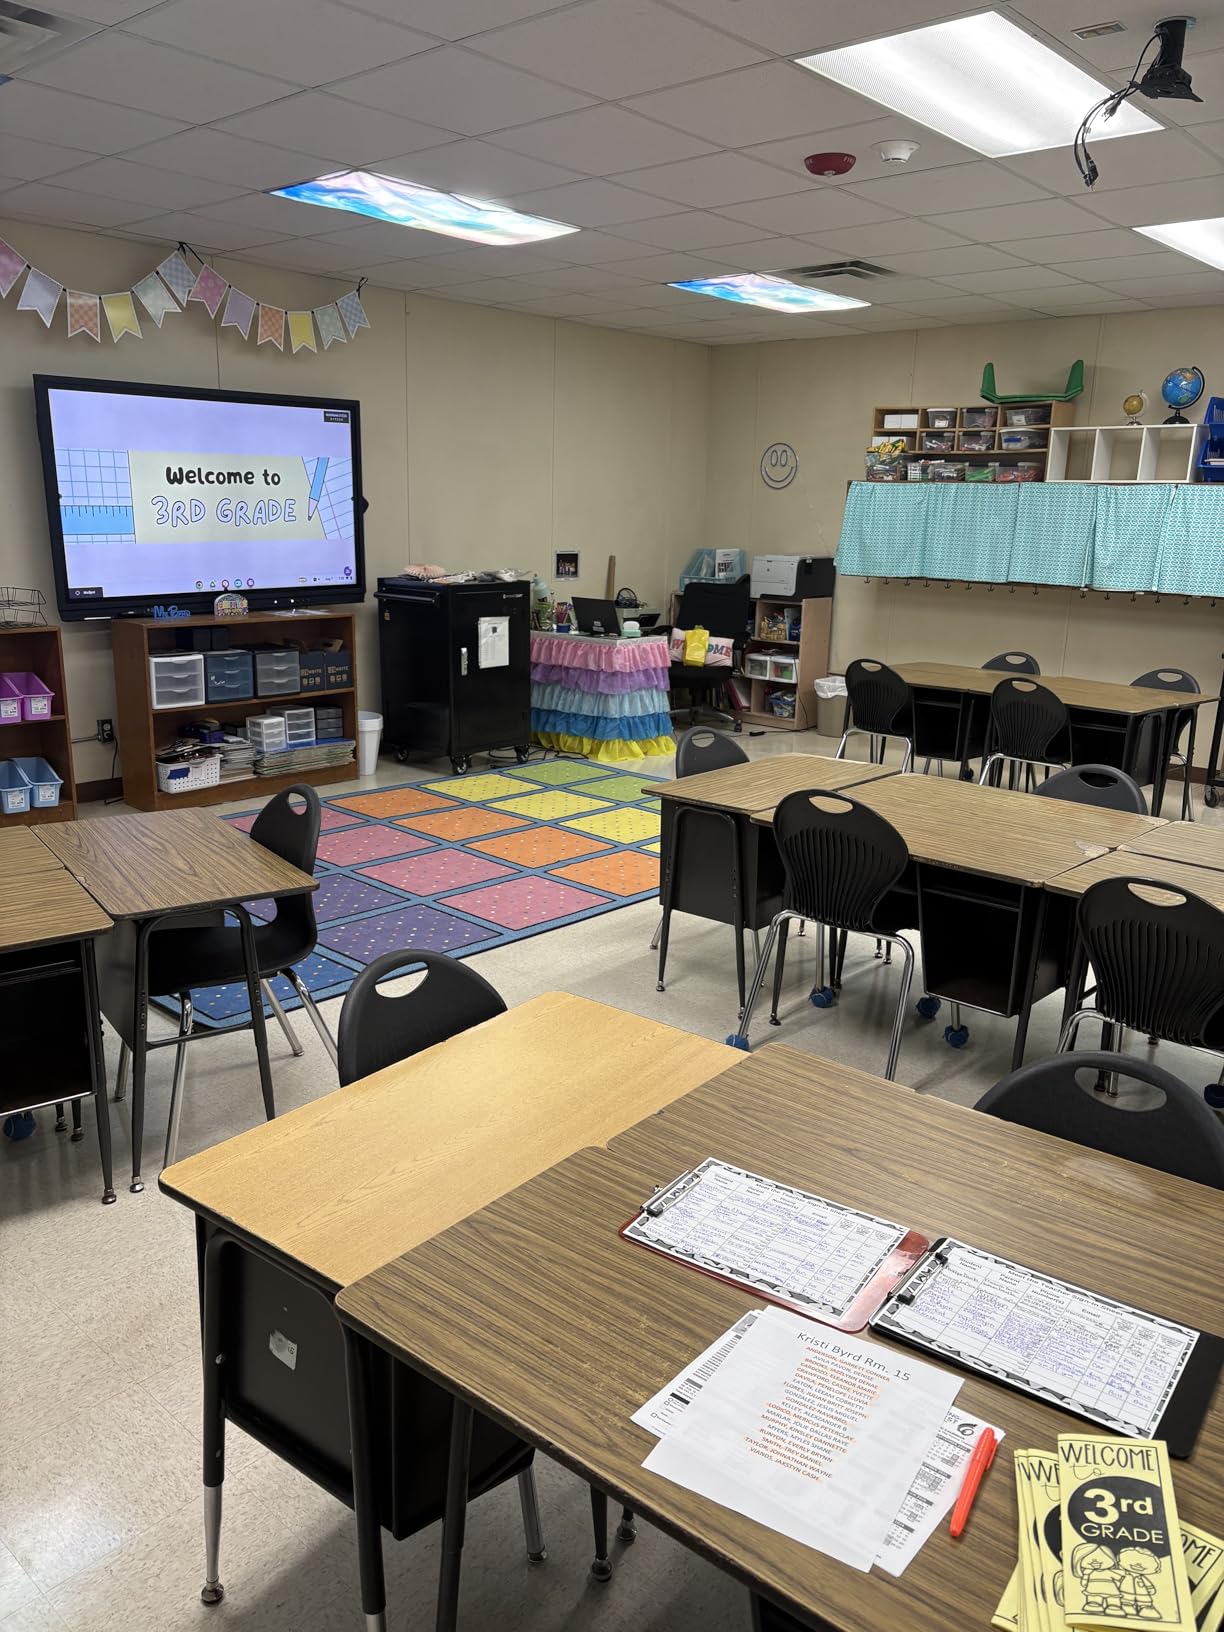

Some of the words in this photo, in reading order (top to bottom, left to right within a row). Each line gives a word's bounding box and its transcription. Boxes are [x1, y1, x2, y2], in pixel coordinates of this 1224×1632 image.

[165, 466, 254, 484] Welcome
[263, 469, 280, 486] to
[151, 496, 206, 527] 3RD
[216, 498, 296, 527] GRADE
[1007, 1270, 1026, 1279] Meet
[1040, 1282, 1071, 1296] Teacher
[1099, 1305, 1123, 1316] Sheet
[796, 1332, 830, 1349] Kristi
[830, 1345, 862, 1362] Byrd
[863, 1357, 891, 1372] Rm.
[892, 1369, 912, 1381] 15
[791, 1378, 815, 1390] EATON,
[828, 1374, 857, 1387] ELEANOR
[856, 1384, 877, 1395] MARIE
[852, 1370, 874, 1381] DENISE
[864, 1369, 891, 1381] CONNER
[782, 1381, 807, 1394] FLORES,
[805, 1391, 827, 1402] JULIAN
[844, 1407, 867, 1418] JOSEPH
[817, 1382, 848, 1396] PENELOPE
[847, 1394, 869, 1405] LLUVIA
[831, 1381, 852, 1391] CASSIE
[850, 1389, 873, 1400] YVETTE
[780, 1401, 803, 1413] KELLEY,
[816, 1402, 834, 1412] JESUS
[833, 1409, 859, 1422] MIGUEL
[760, 1414, 789, 1429] MURPHY,
[788, 1426, 813, 1439] KINSLEY
[812, 1436, 847, 1453] DANNETTE
[766, 1423, 790, 1436] MYERS,
[789, 1433, 811, 1445] MYLES
[809, 1442, 832, 1455] SHANE
[808, 1427, 833, 1439] DALLAS
[831, 1436, 848, 1446] RAYE
[743, 1436, 770, 1451] TAYLOR,
[769, 1447, 808, 1468] JOHNATHAN
[807, 1464, 832, 1478] WAYNE
[787, 1440, 810, 1453] EVERLY
[810, 1450, 833, 1463] BRYNN
[798, 1453, 823, 1466] DANIEL
[1060, 1442, 1155, 1472] WELCOME
[800, 1469, 819, 1480] CASH
[1069, 1463, 1104, 1480] to
[1083, 1487, 1153, 1525] 3rd
[1080, 1522, 1164, 1544] GRADE
